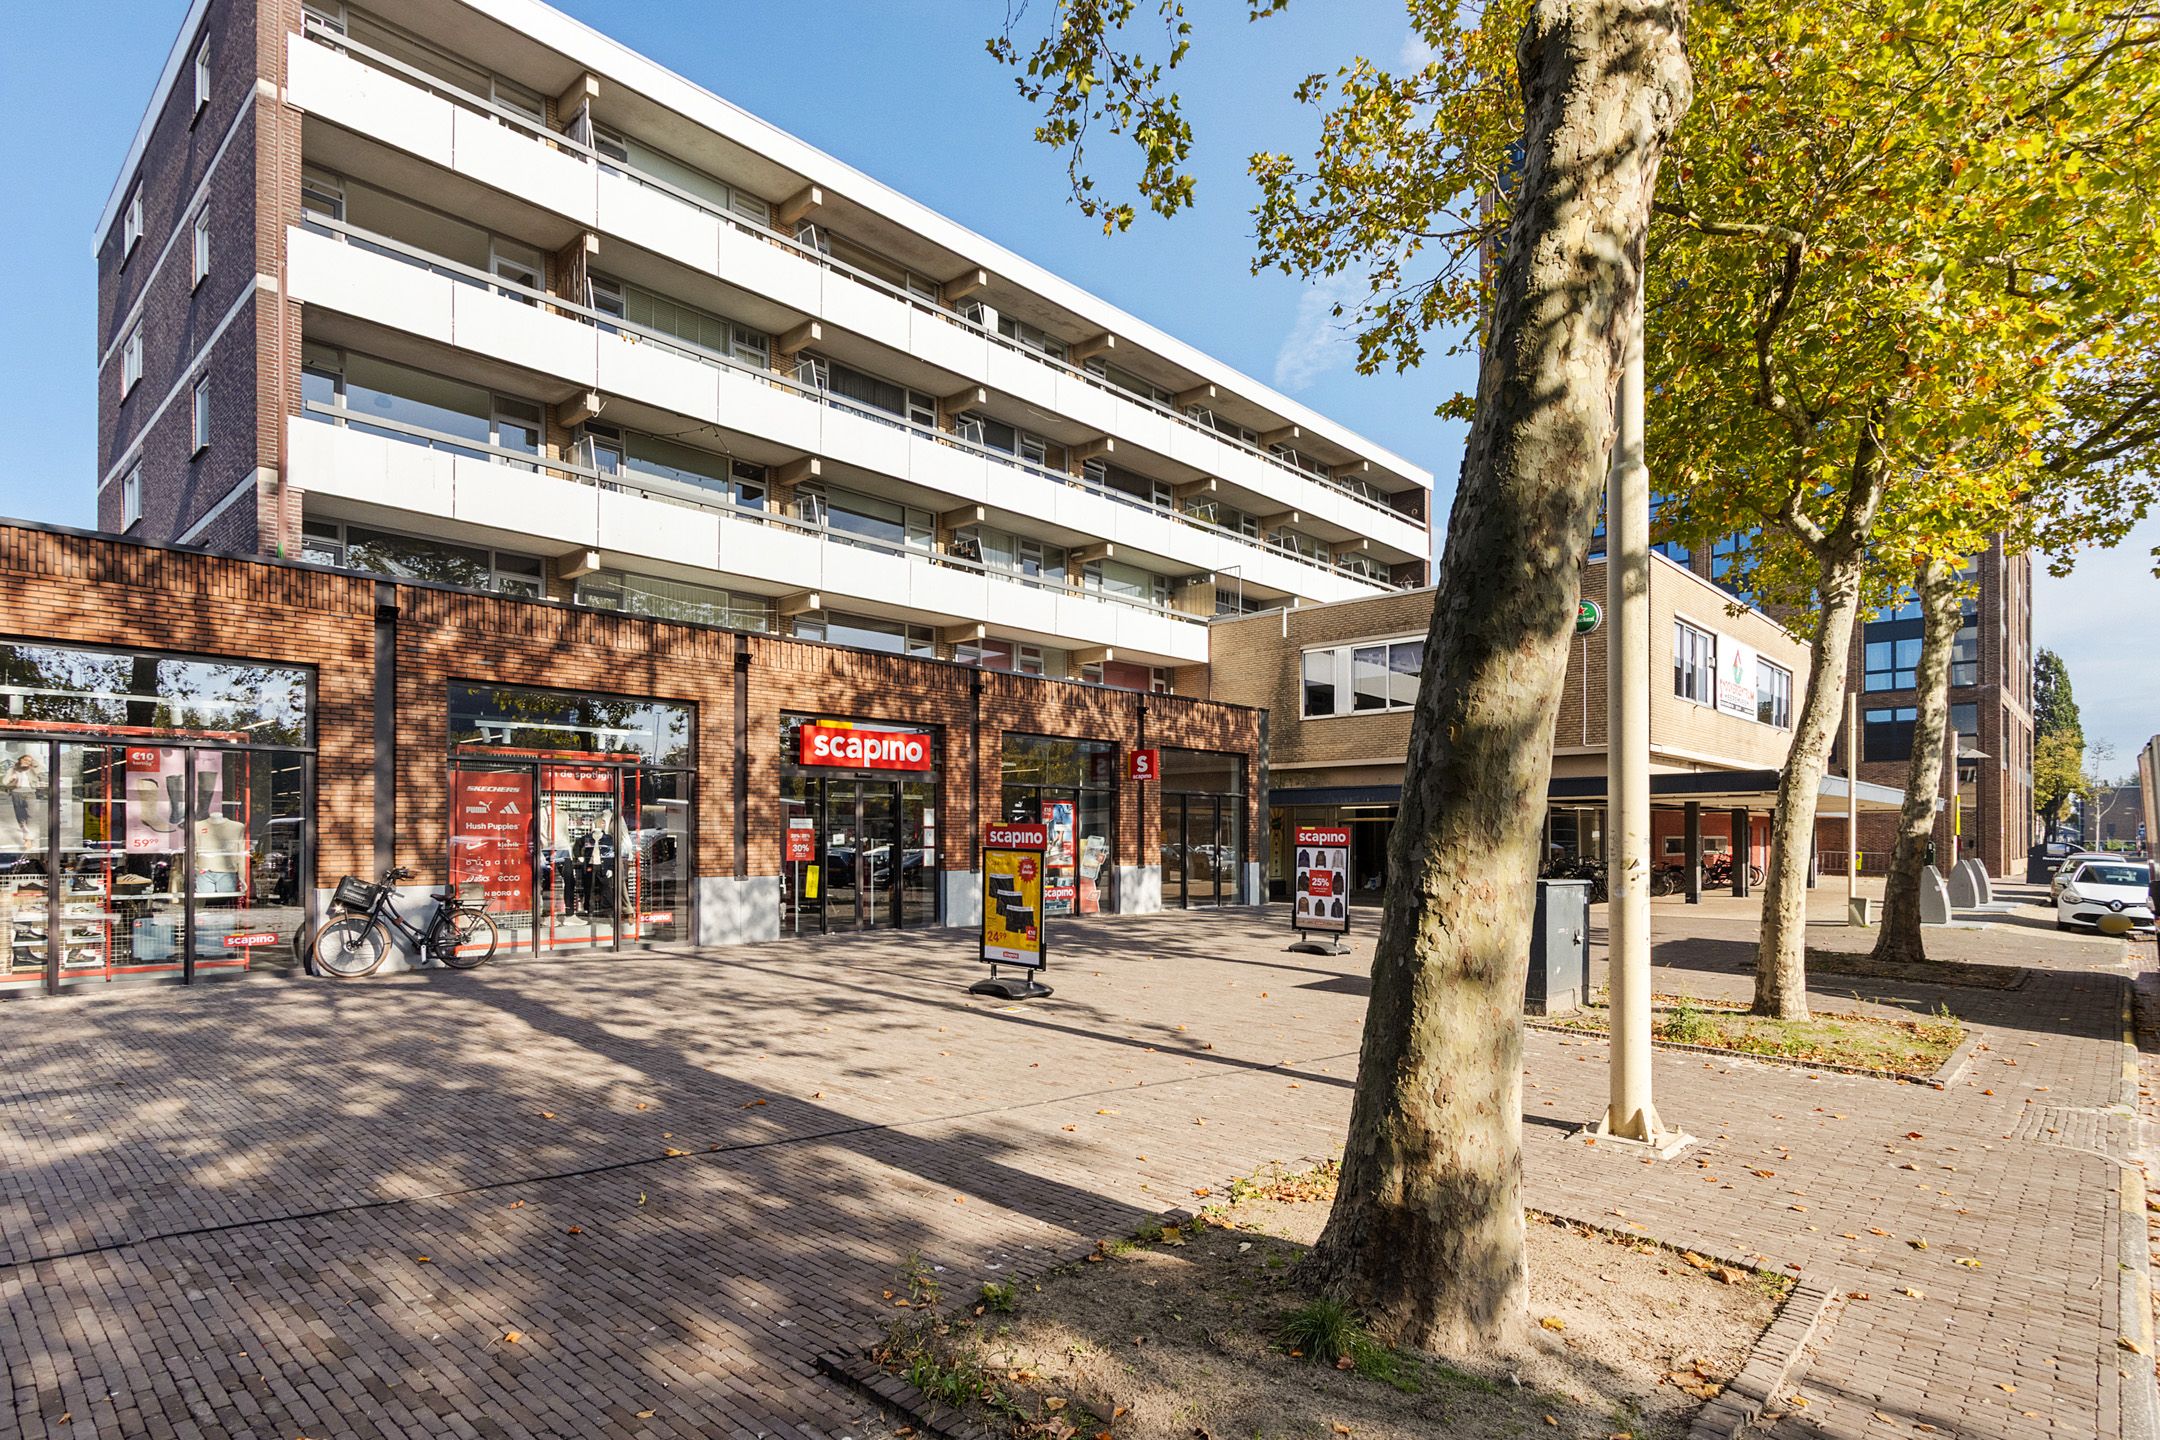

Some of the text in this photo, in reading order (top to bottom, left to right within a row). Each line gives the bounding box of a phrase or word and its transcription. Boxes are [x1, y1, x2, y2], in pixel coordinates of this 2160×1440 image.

[132, 752, 154, 760] €10
[814, 735, 923, 767] scapino
[1136, 755, 1148, 773] S
[560, 769, 573, 778] de
[575, 770, 613, 781] spotligh
[466, 785, 520, 793] SKECHERS
[465, 822, 519, 831] Hush Puppies
[990, 831, 1043, 848] scapino
[1299, 833, 1346, 845] scapino
[1312, 878, 1329, 886] 25%
[1044, 888, 1073, 899] scapino
[228, 936, 275, 946] scapino
